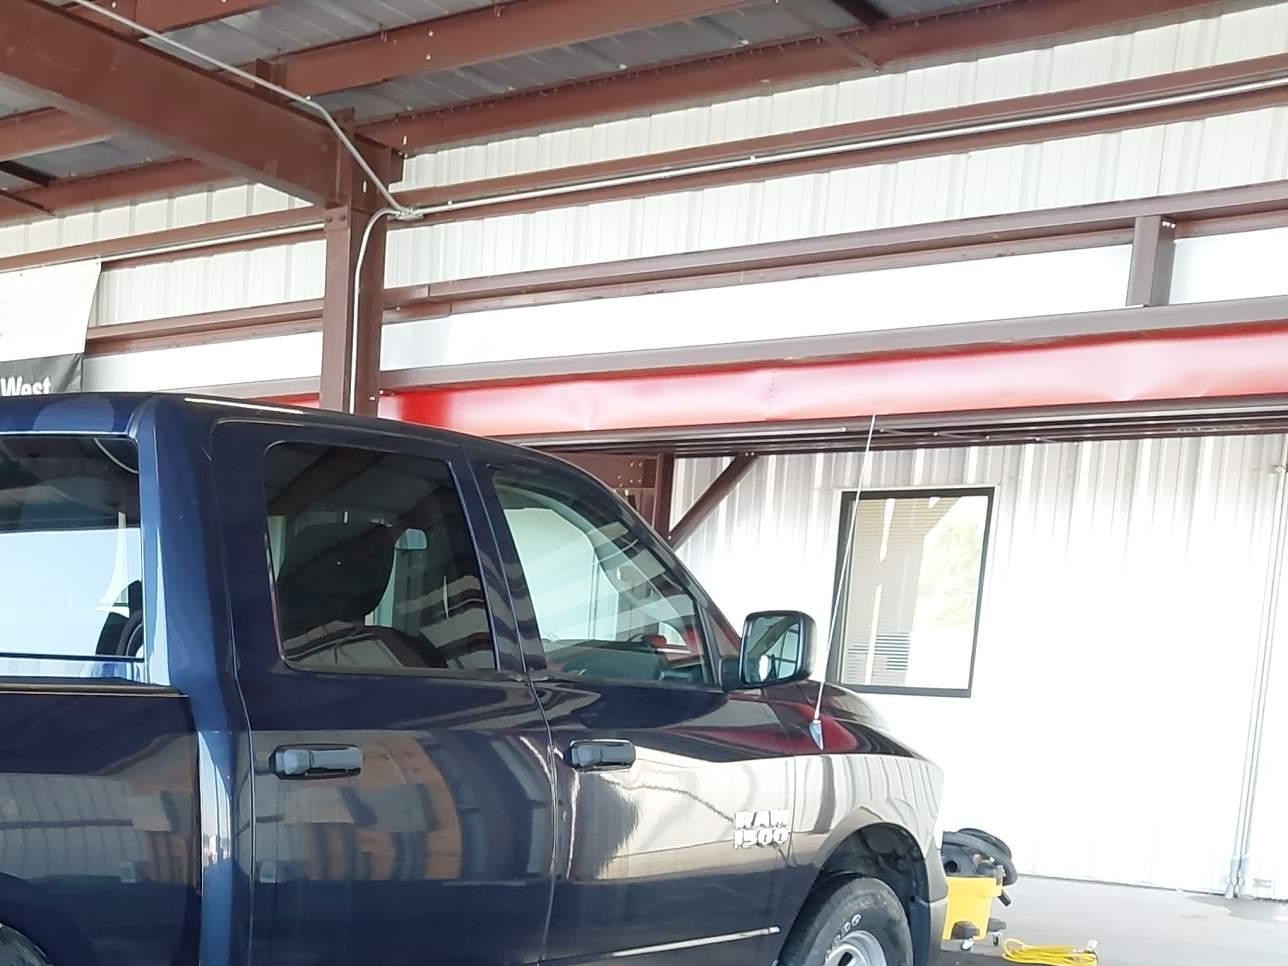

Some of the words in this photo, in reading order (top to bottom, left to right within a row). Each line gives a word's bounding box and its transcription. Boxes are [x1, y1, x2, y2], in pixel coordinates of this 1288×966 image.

[0, 375, 52, 397] West
[735, 809, 792, 829] RAM
[734, 829, 789, 849] 1500
